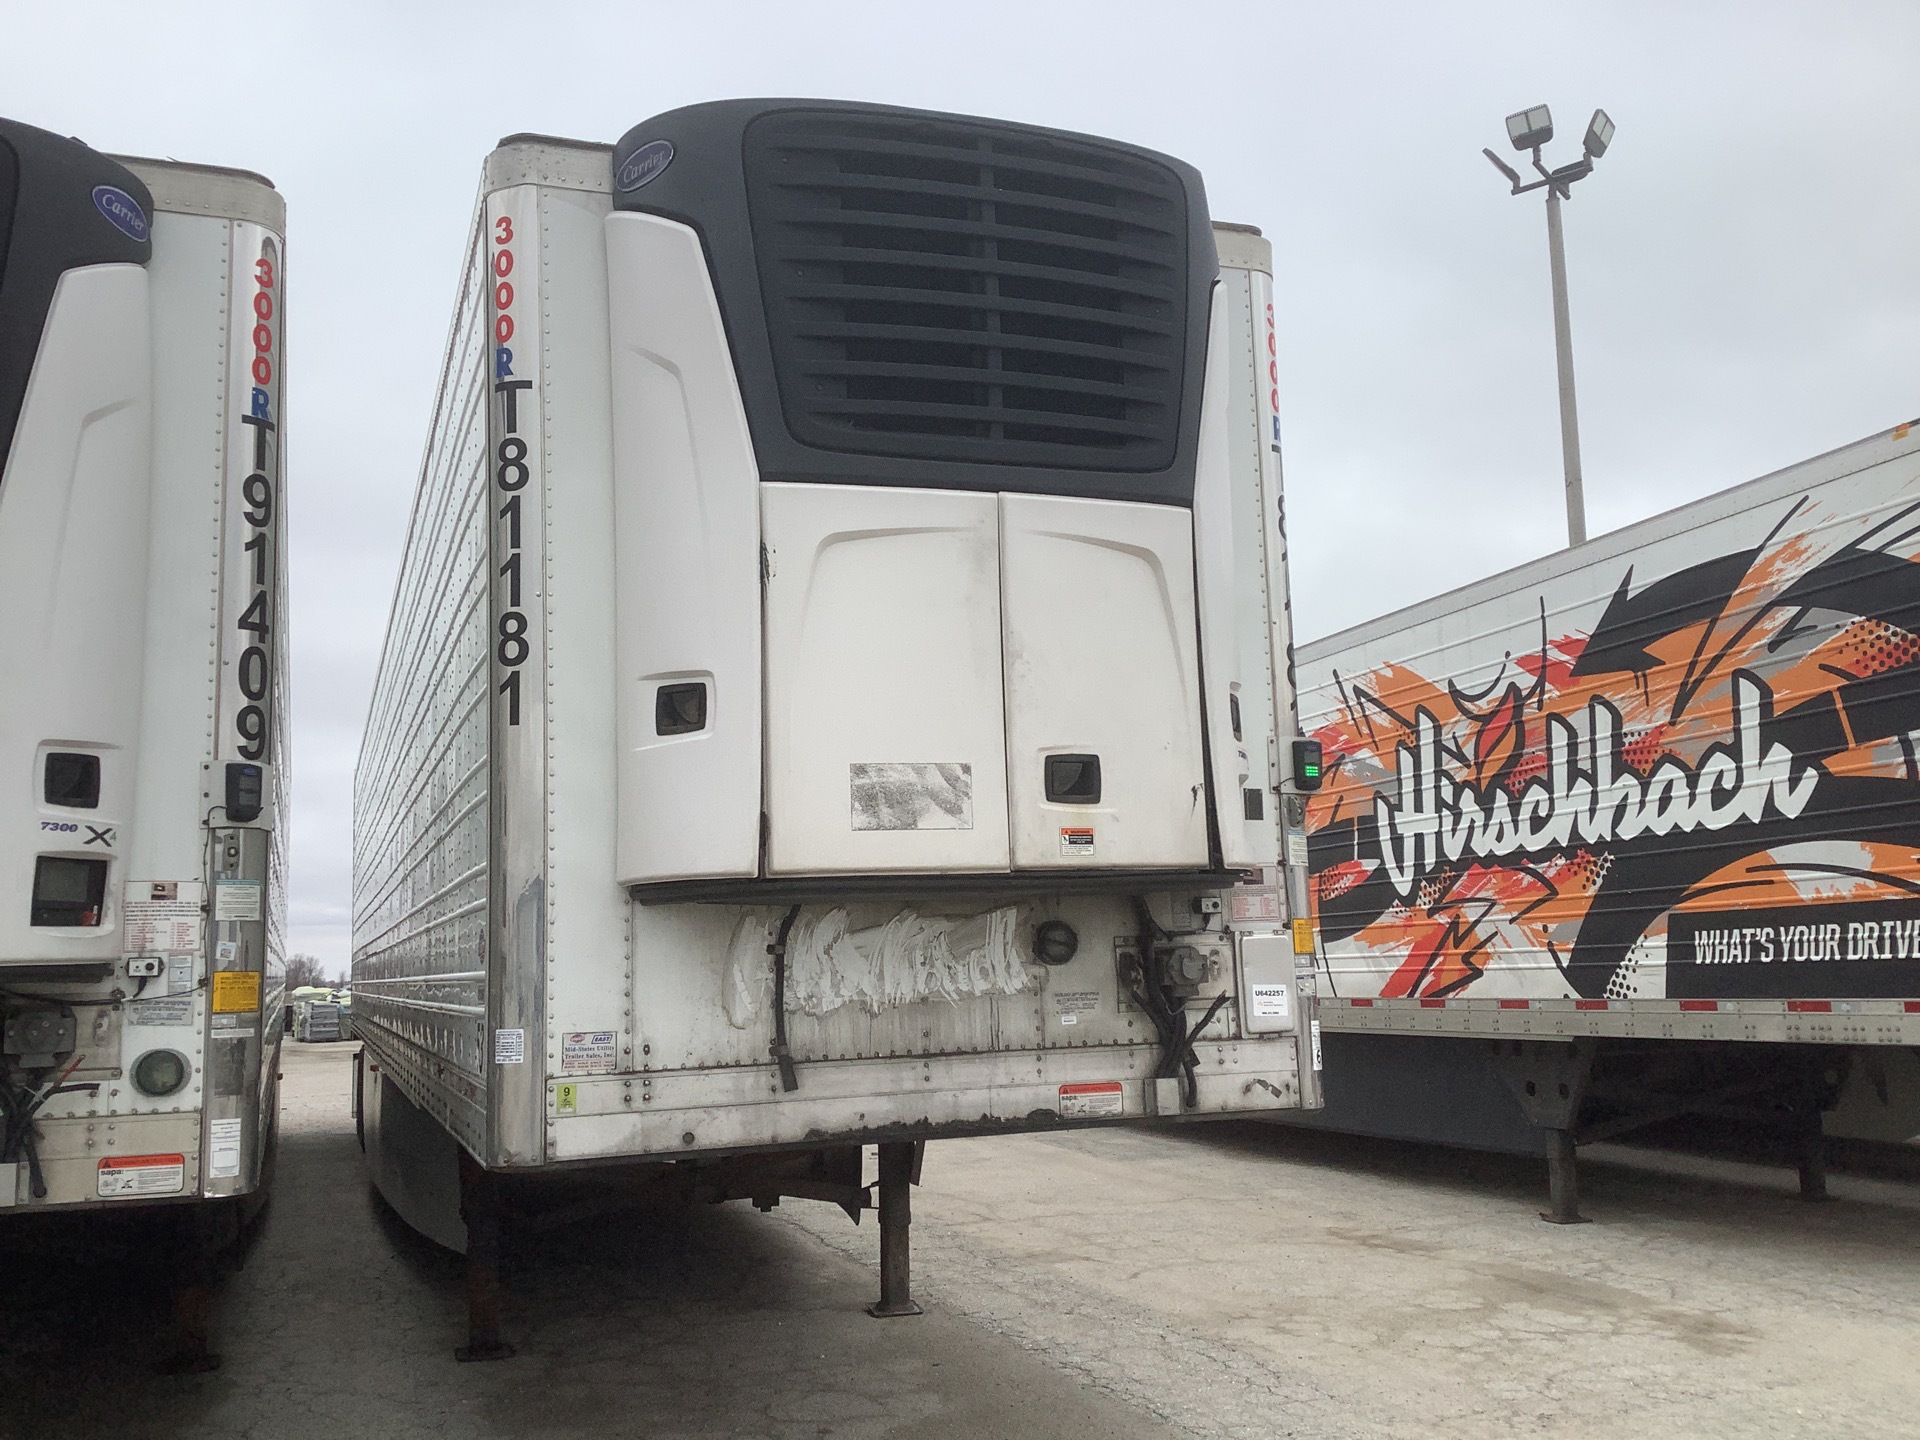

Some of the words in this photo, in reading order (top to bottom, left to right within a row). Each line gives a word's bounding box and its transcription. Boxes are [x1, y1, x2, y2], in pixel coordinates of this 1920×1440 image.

[102, 194, 144, 231] Carrier
[624, 150, 665, 182] Carrier
[251, 258, 274, 420] 3000R
[495, 216, 514, 378] 3000R
[236, 414, 275, 761] T91409
[495, 380, 533, 726] T81181
[40, 821, 78, 832] 7300
[1378, 669, 1819, 897] Hirschbach
[1694, 926, 1775, 964] WHAT'S
[1780, 923, 1841, 962] YOUR
[563, 1086, 571, 1097] 9
